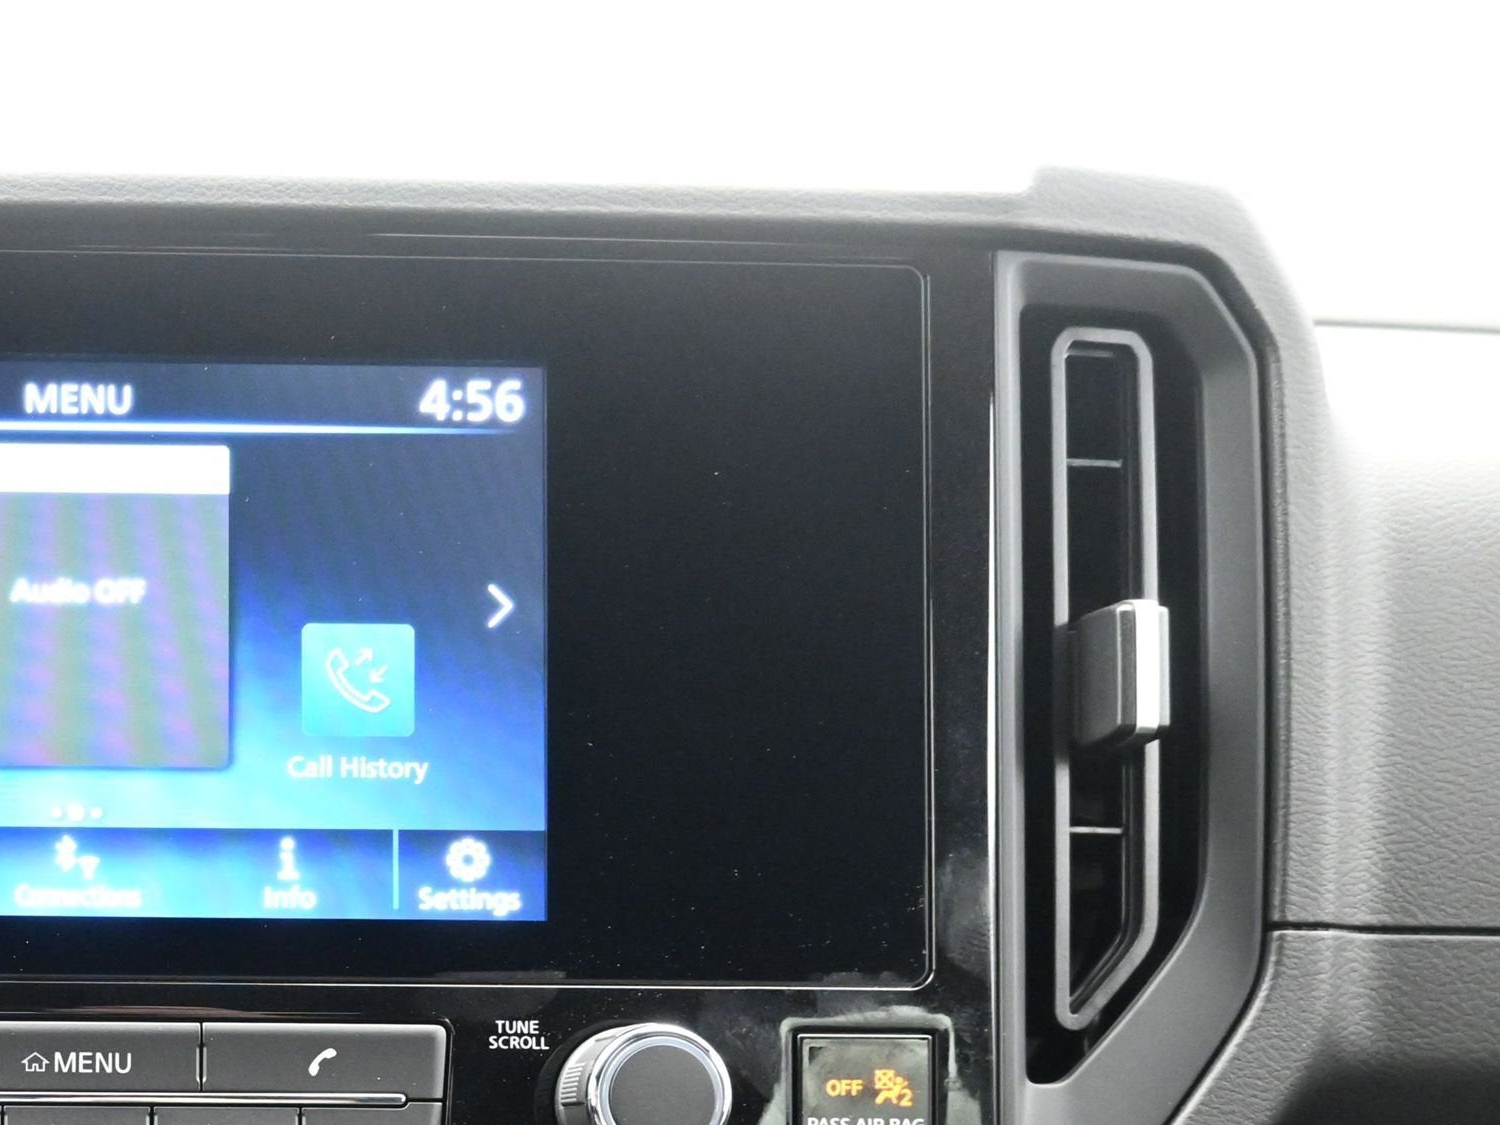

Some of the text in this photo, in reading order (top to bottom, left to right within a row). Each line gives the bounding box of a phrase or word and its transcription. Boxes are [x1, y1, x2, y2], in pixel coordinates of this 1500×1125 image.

[24, 383, 132, 415] MENU
[419, 381, 525, 421] 4:56
[9, 577, 146, 604] Audio OFF
[287, 756, 428, 785] Call History
[264, 885, 317, 909] Info
[418, 886, 522, 917] Settings
[495, 1020, 540, 1034] TUNE
[488, 1035, 550, 1050] SCROLL
[53, 1051, 132, 1074] MENU
[825, 1079, 864, 1097] OFF
